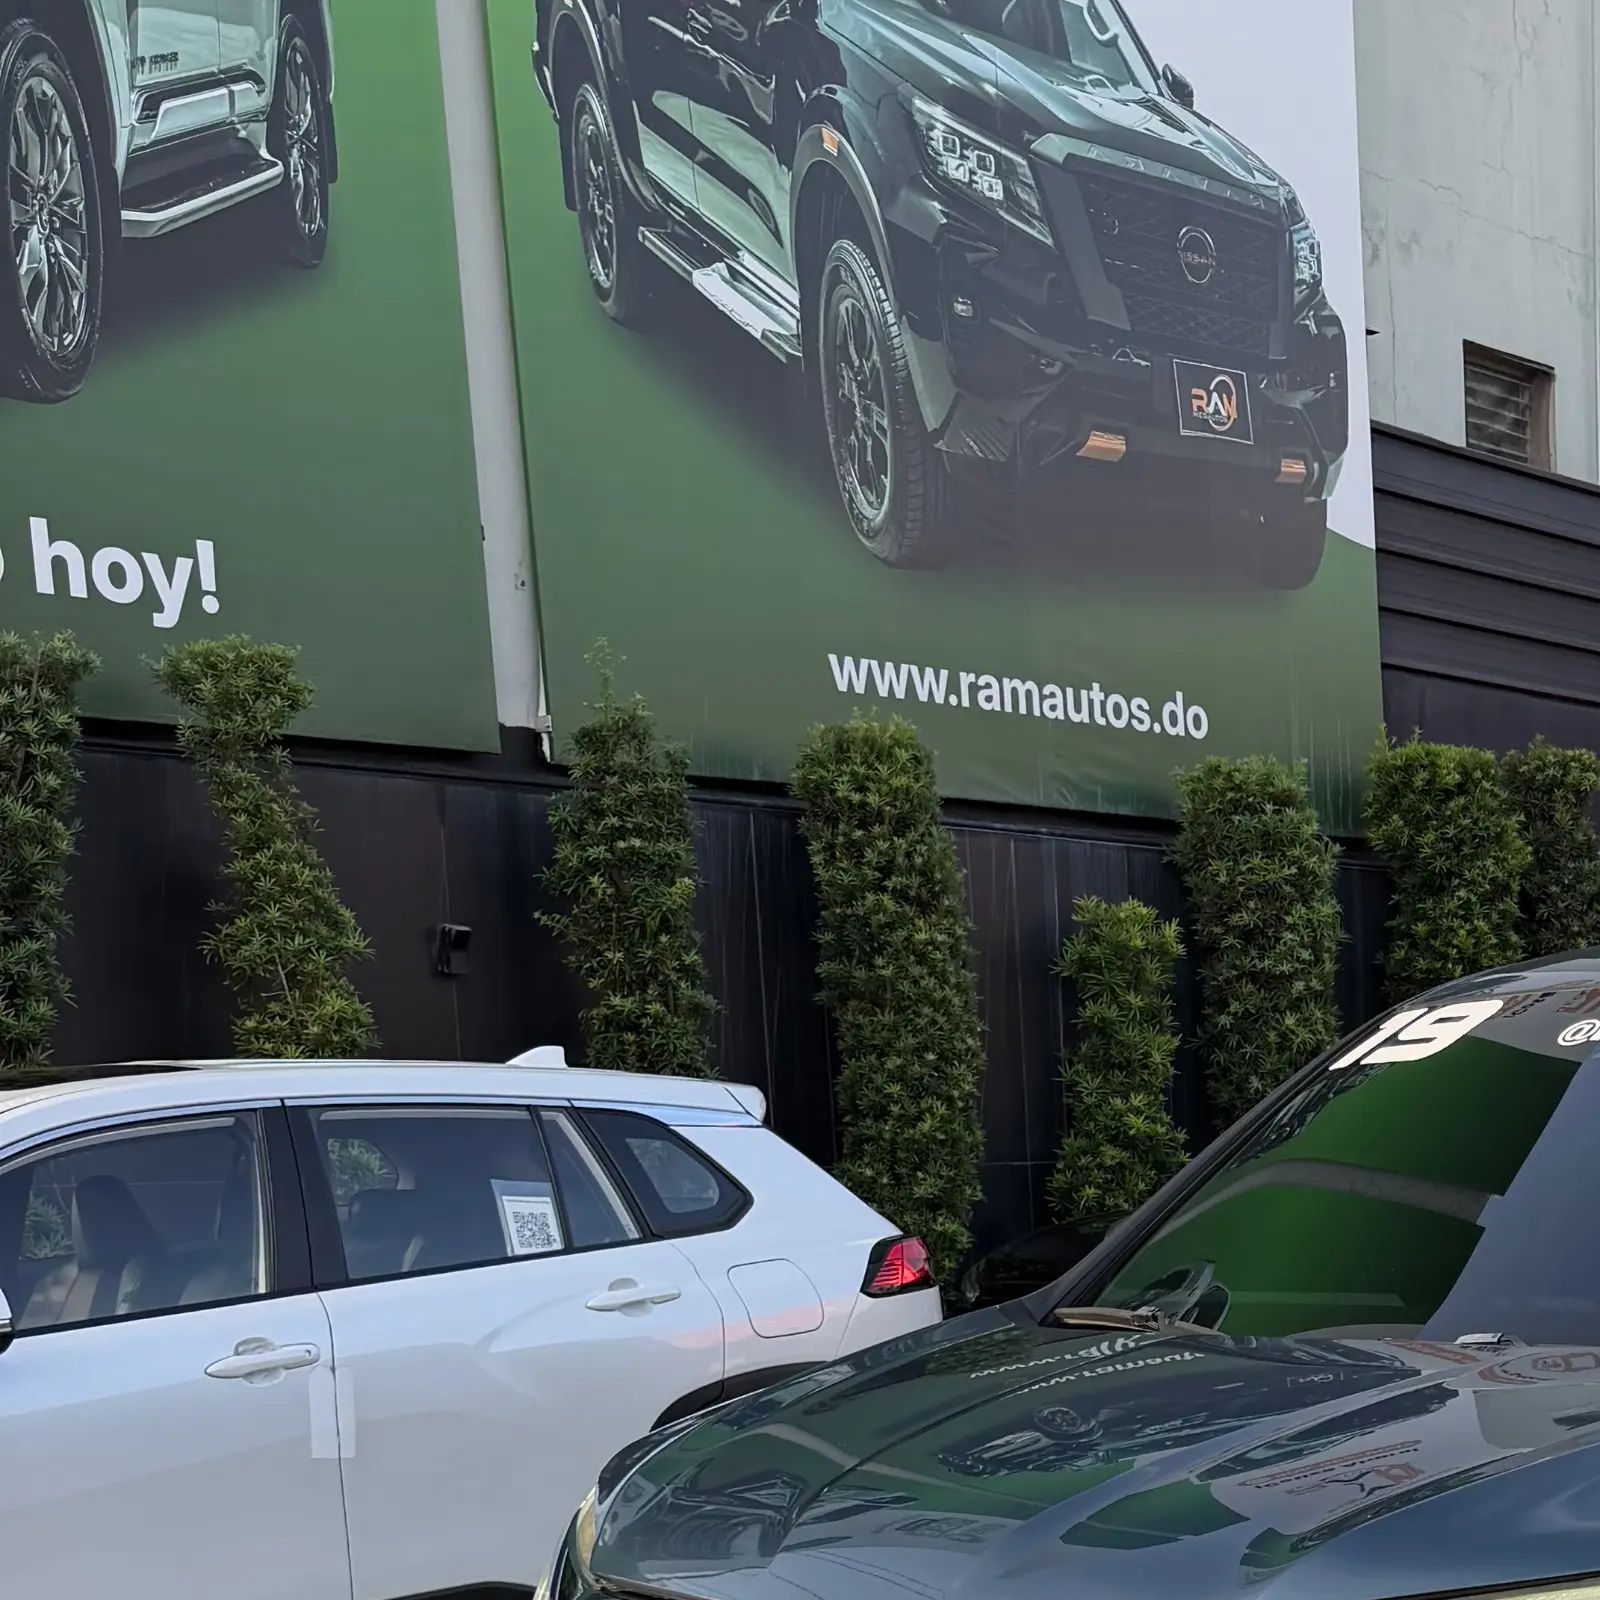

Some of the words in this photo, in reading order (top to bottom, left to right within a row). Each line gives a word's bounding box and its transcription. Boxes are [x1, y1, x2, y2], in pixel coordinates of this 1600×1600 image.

[29, 516, 220, 629] hoy!
[827, 653, 1209, 740] www.ramautos.do
[1328, 999, 1504, 1071] 19
